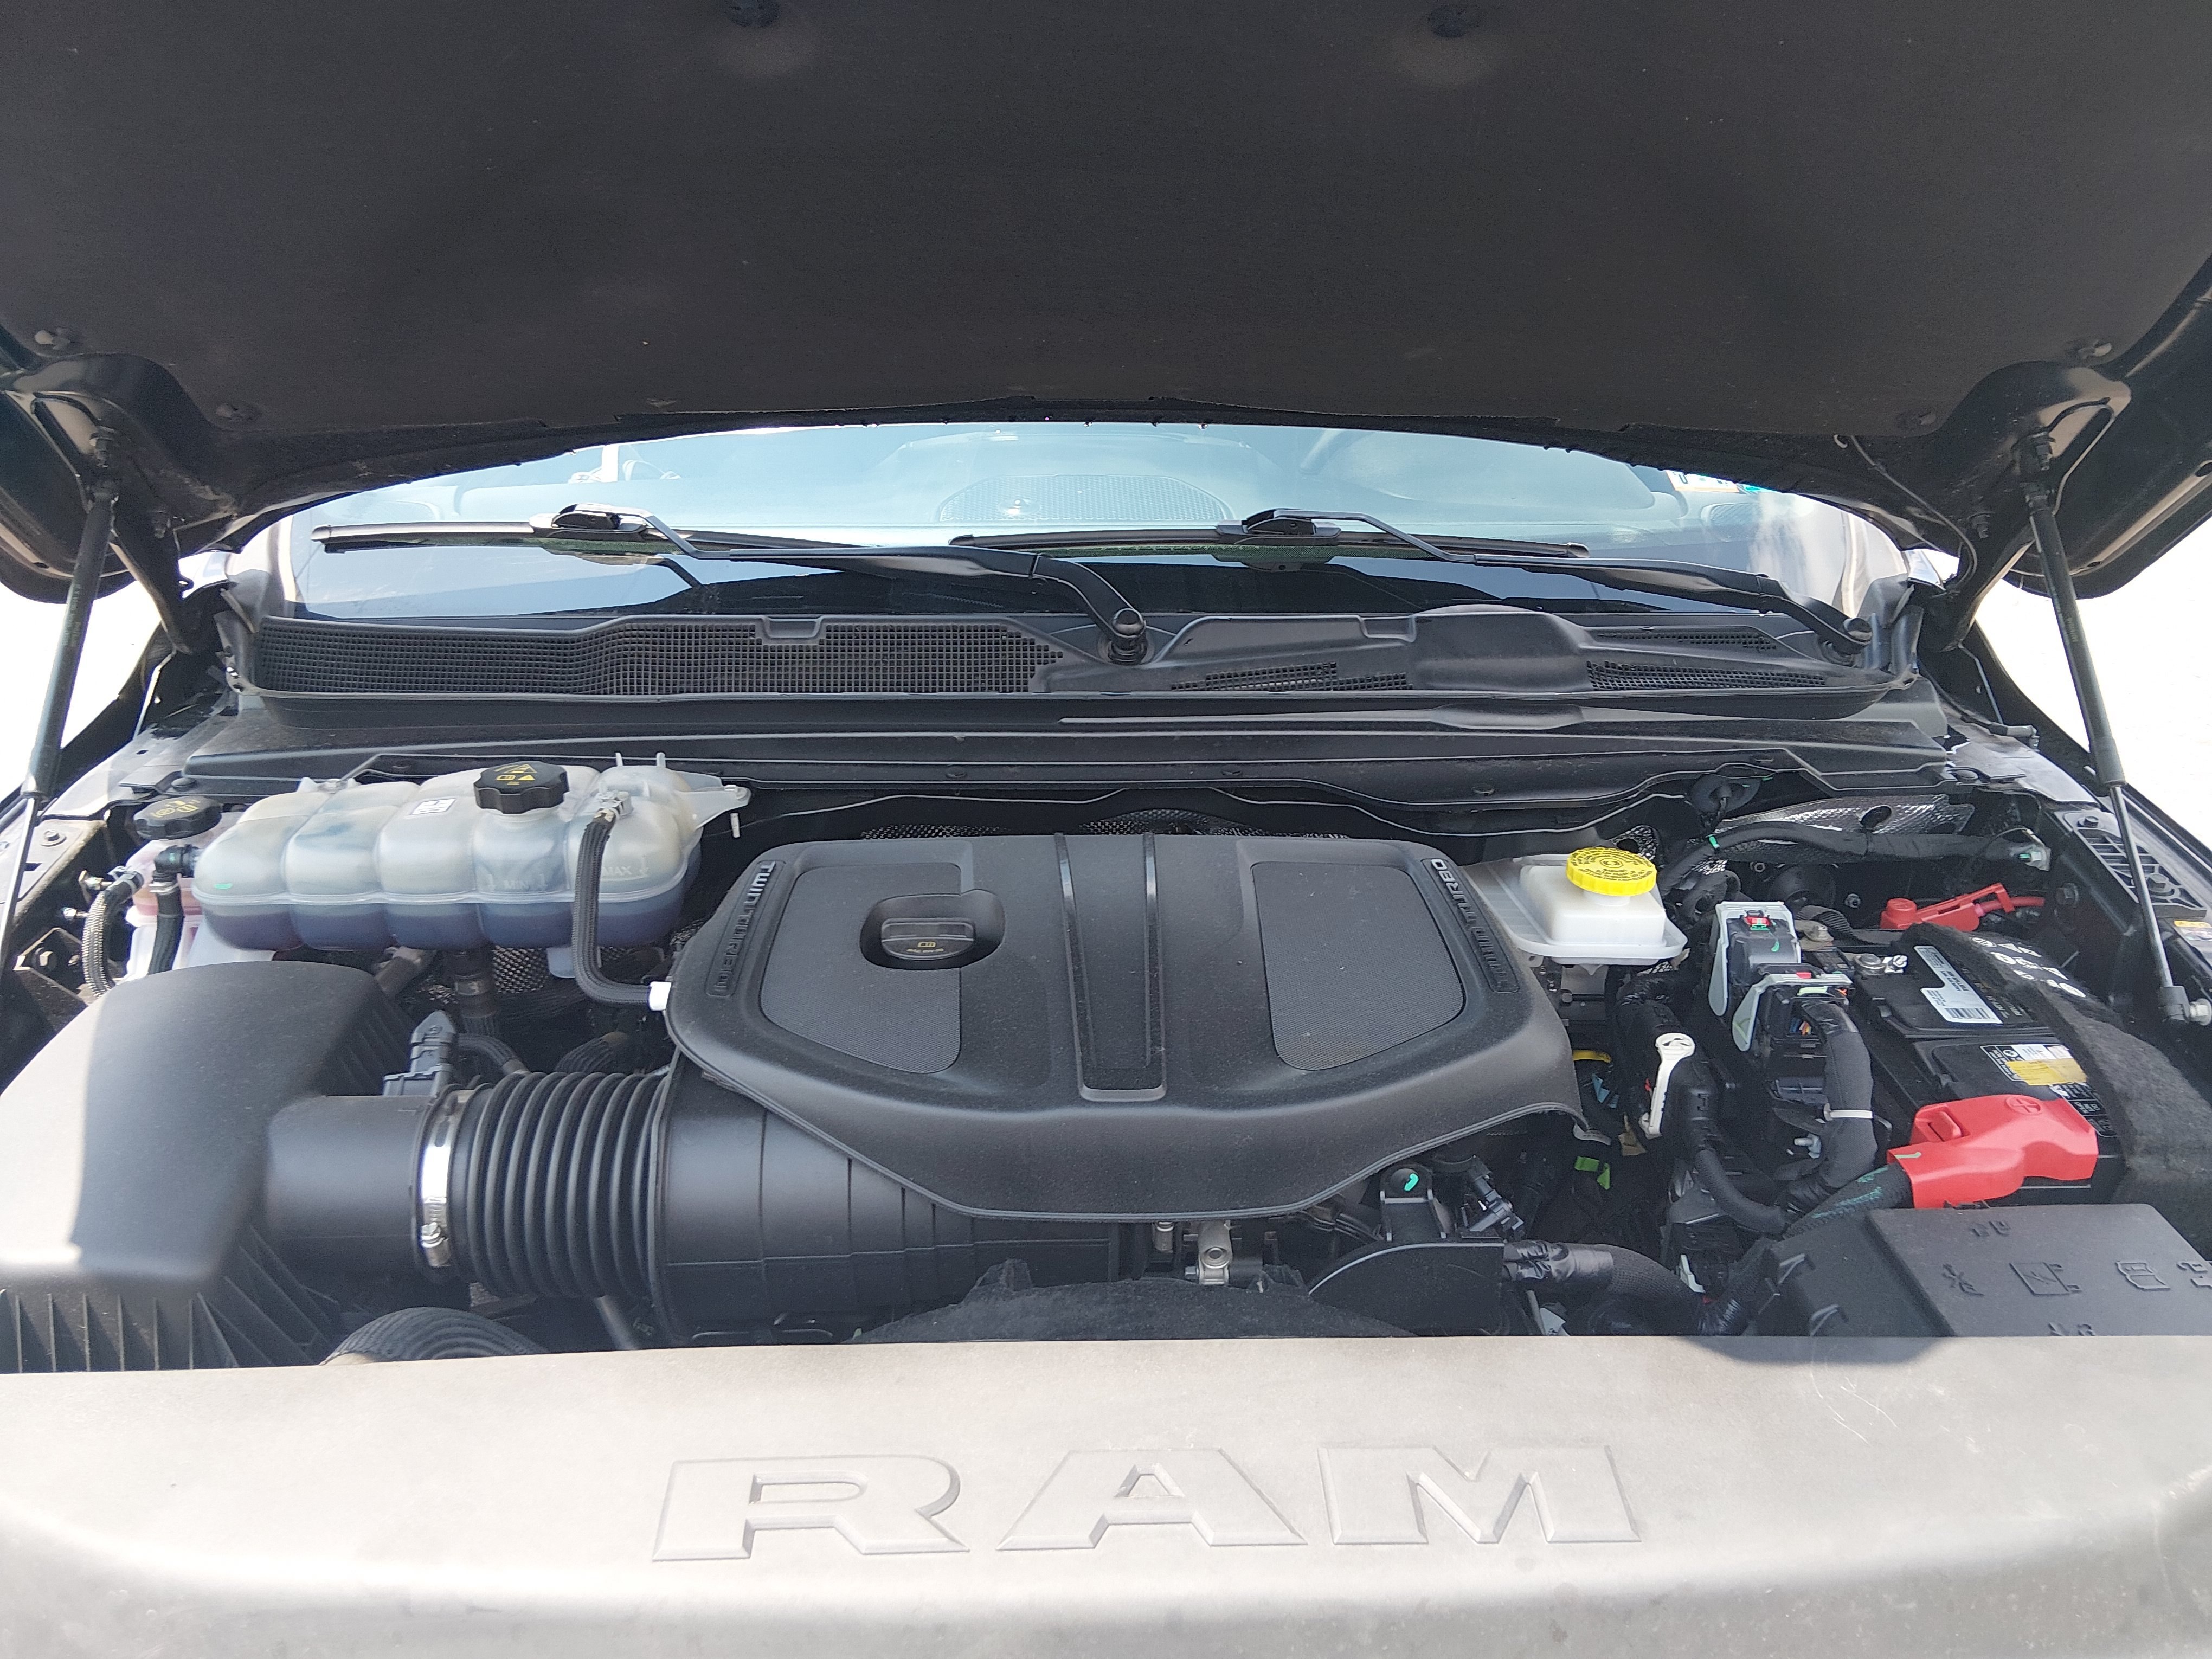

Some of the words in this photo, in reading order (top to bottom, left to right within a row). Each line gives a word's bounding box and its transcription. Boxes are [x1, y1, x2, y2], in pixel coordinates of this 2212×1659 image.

[744, 860, 776, 904] TWIN
[1431, 859, 1477, 923] TURBO
[652, 1444, 1642, 1562] RAM
